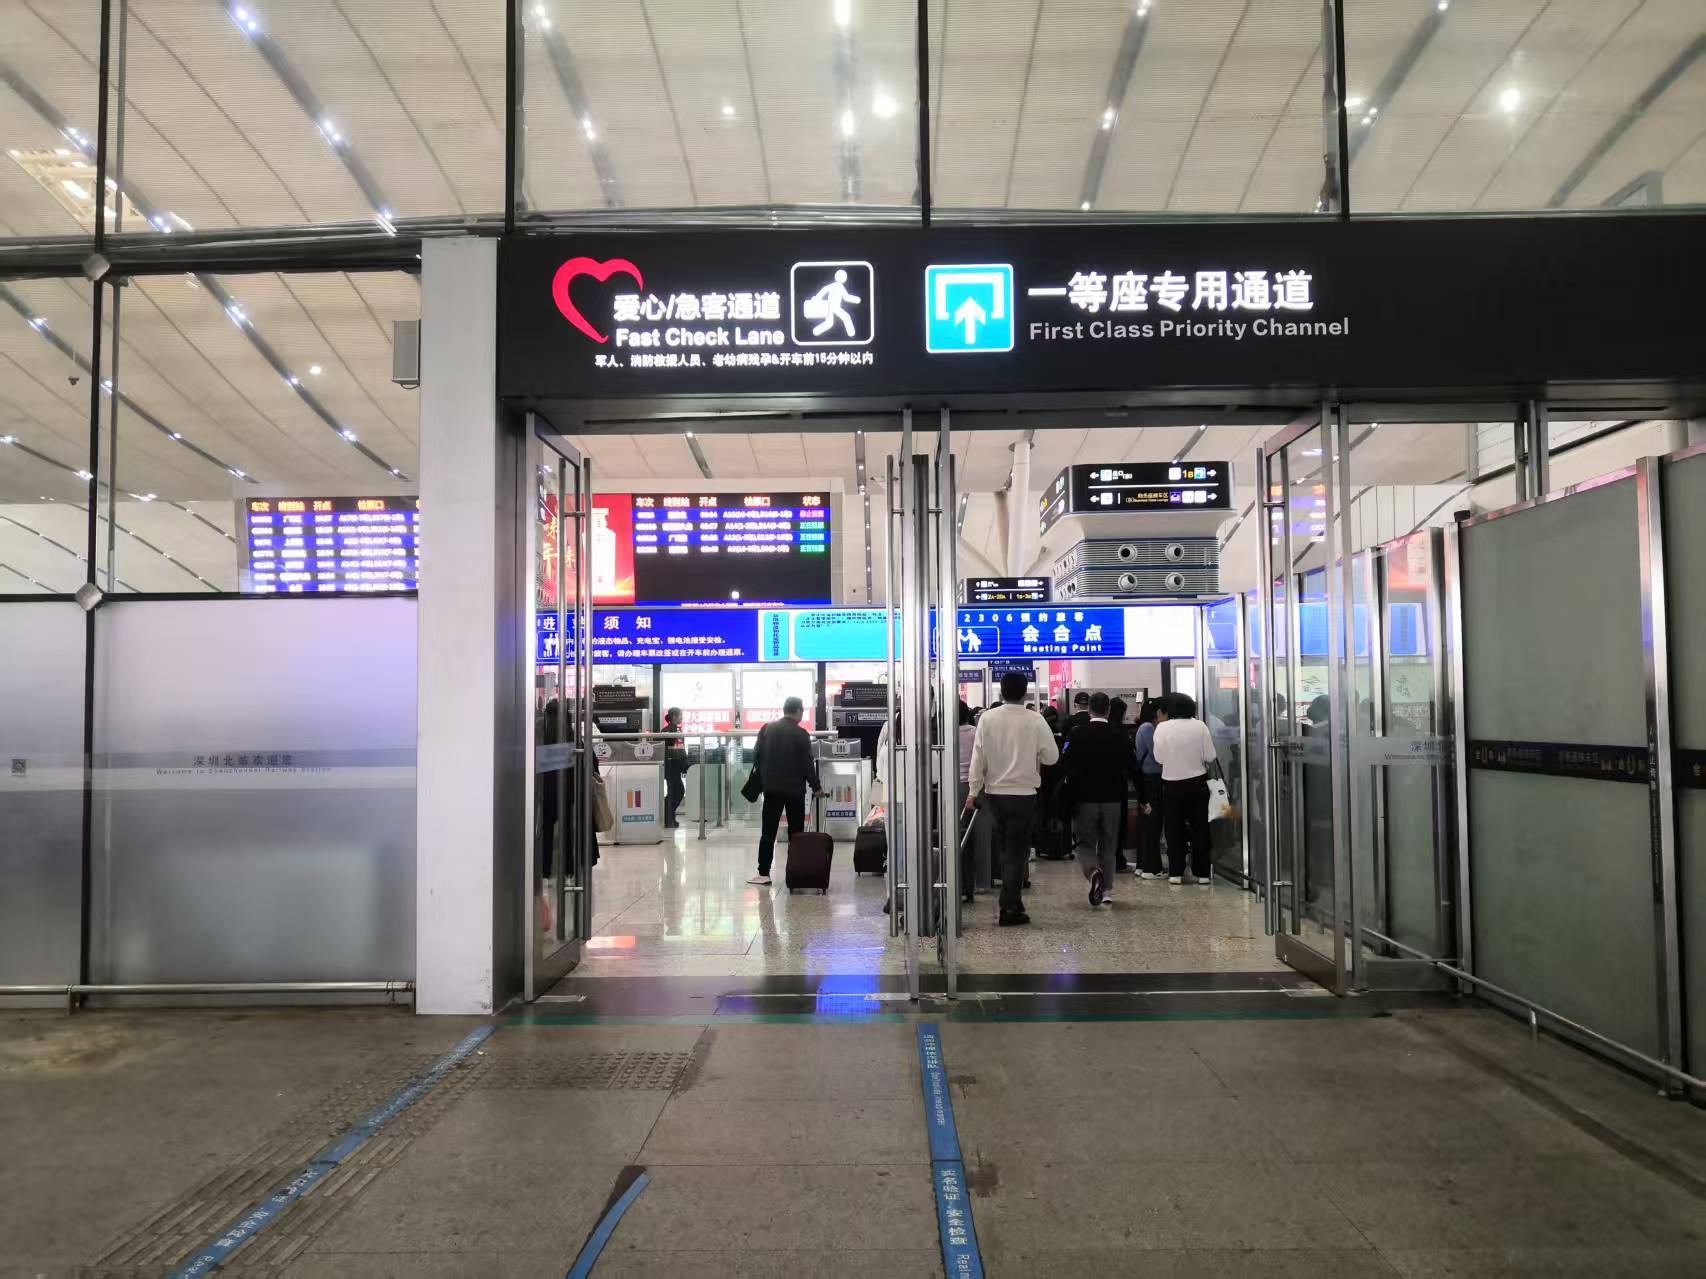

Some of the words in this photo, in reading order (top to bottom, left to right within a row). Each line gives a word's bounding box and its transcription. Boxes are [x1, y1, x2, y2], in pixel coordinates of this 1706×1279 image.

[1028, 269, 1314, 312] 一等座专用通道
[613, 293, 781, 322] 爱心/急客通道
[615, 328, 660, 347] Fast
[665, 327, 729, 346] Check
[735, 326, 785, 346] Lane
[1029, 321, 1084, 340] First
[1089, 320, 1154, 339] Class
[1160, 317, 1247, 340] Priority
[1252, 316, 1349, 337] Channel
[1021, 624, 1103, 642] 会合点
[1023, 644, 1068, 654] Meeting
[1072, 643, 1102, 653] Point
